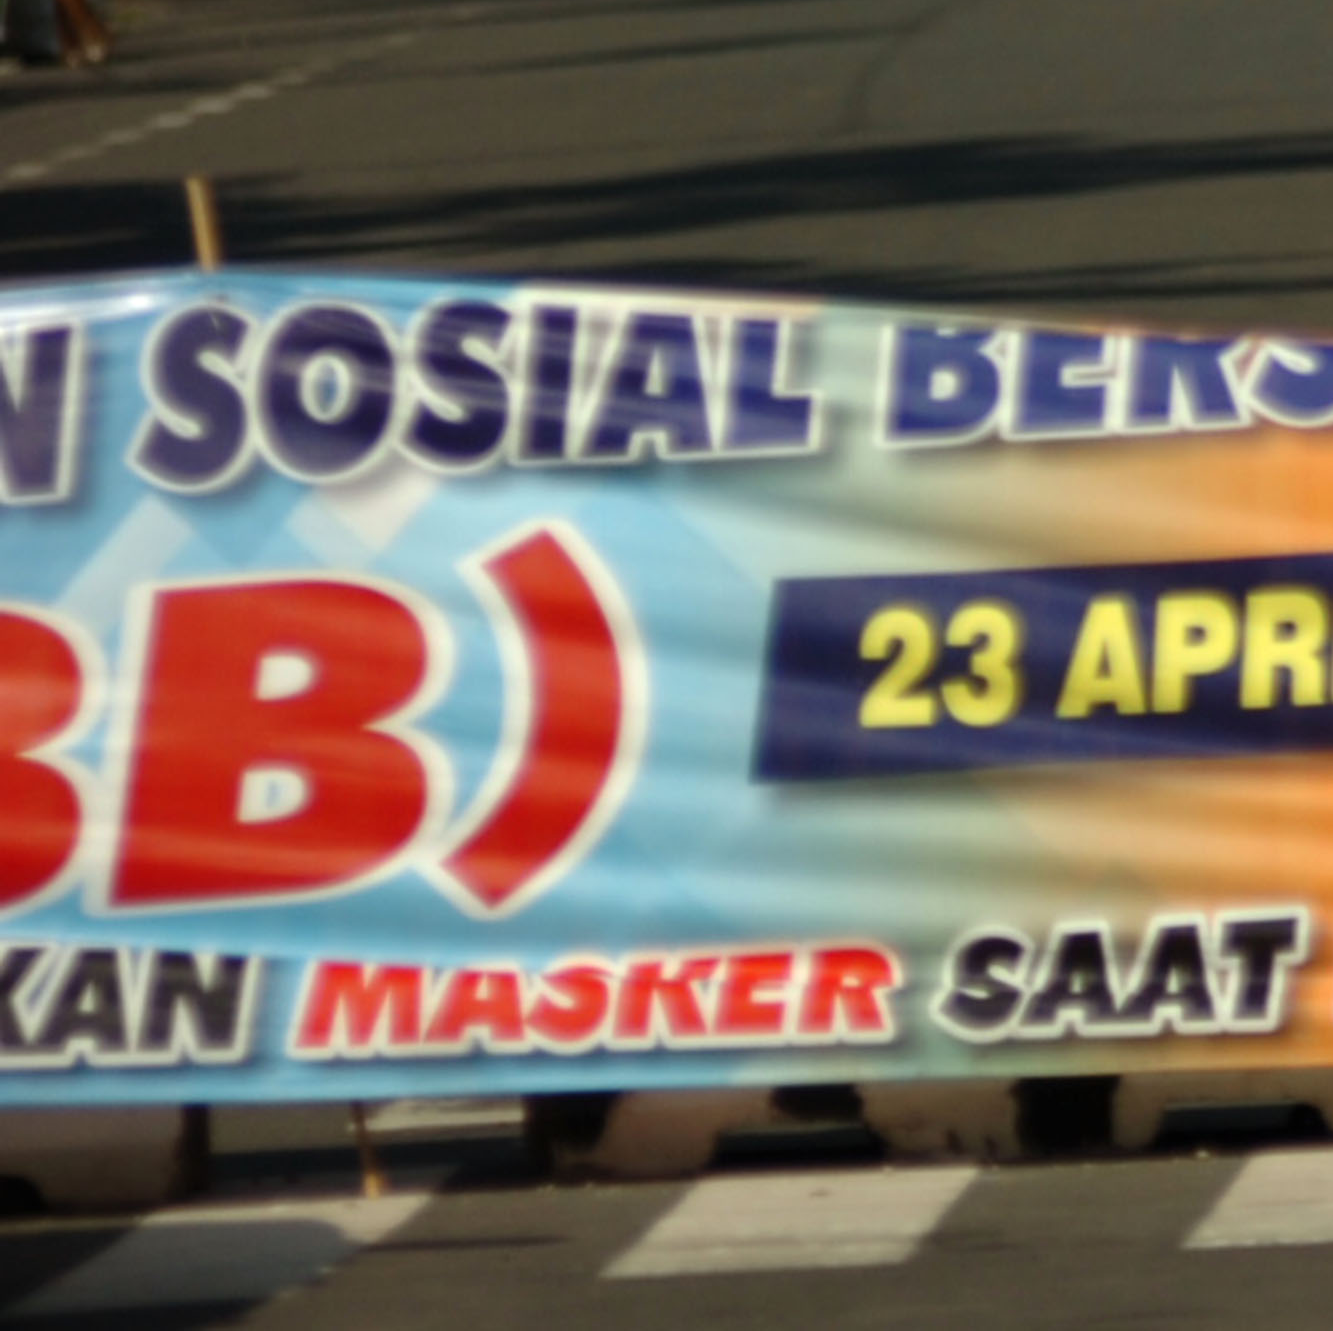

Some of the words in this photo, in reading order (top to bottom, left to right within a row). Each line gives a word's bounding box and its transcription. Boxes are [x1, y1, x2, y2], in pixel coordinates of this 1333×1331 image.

[124, 294, 822, 492] SOSIAL
[0, 517, 650, 922] B)
[858, 601, 1020, 729] 23
[287, 942, 900, 1057] MASKER
[933, 908, 1308, 1042] SAAT
